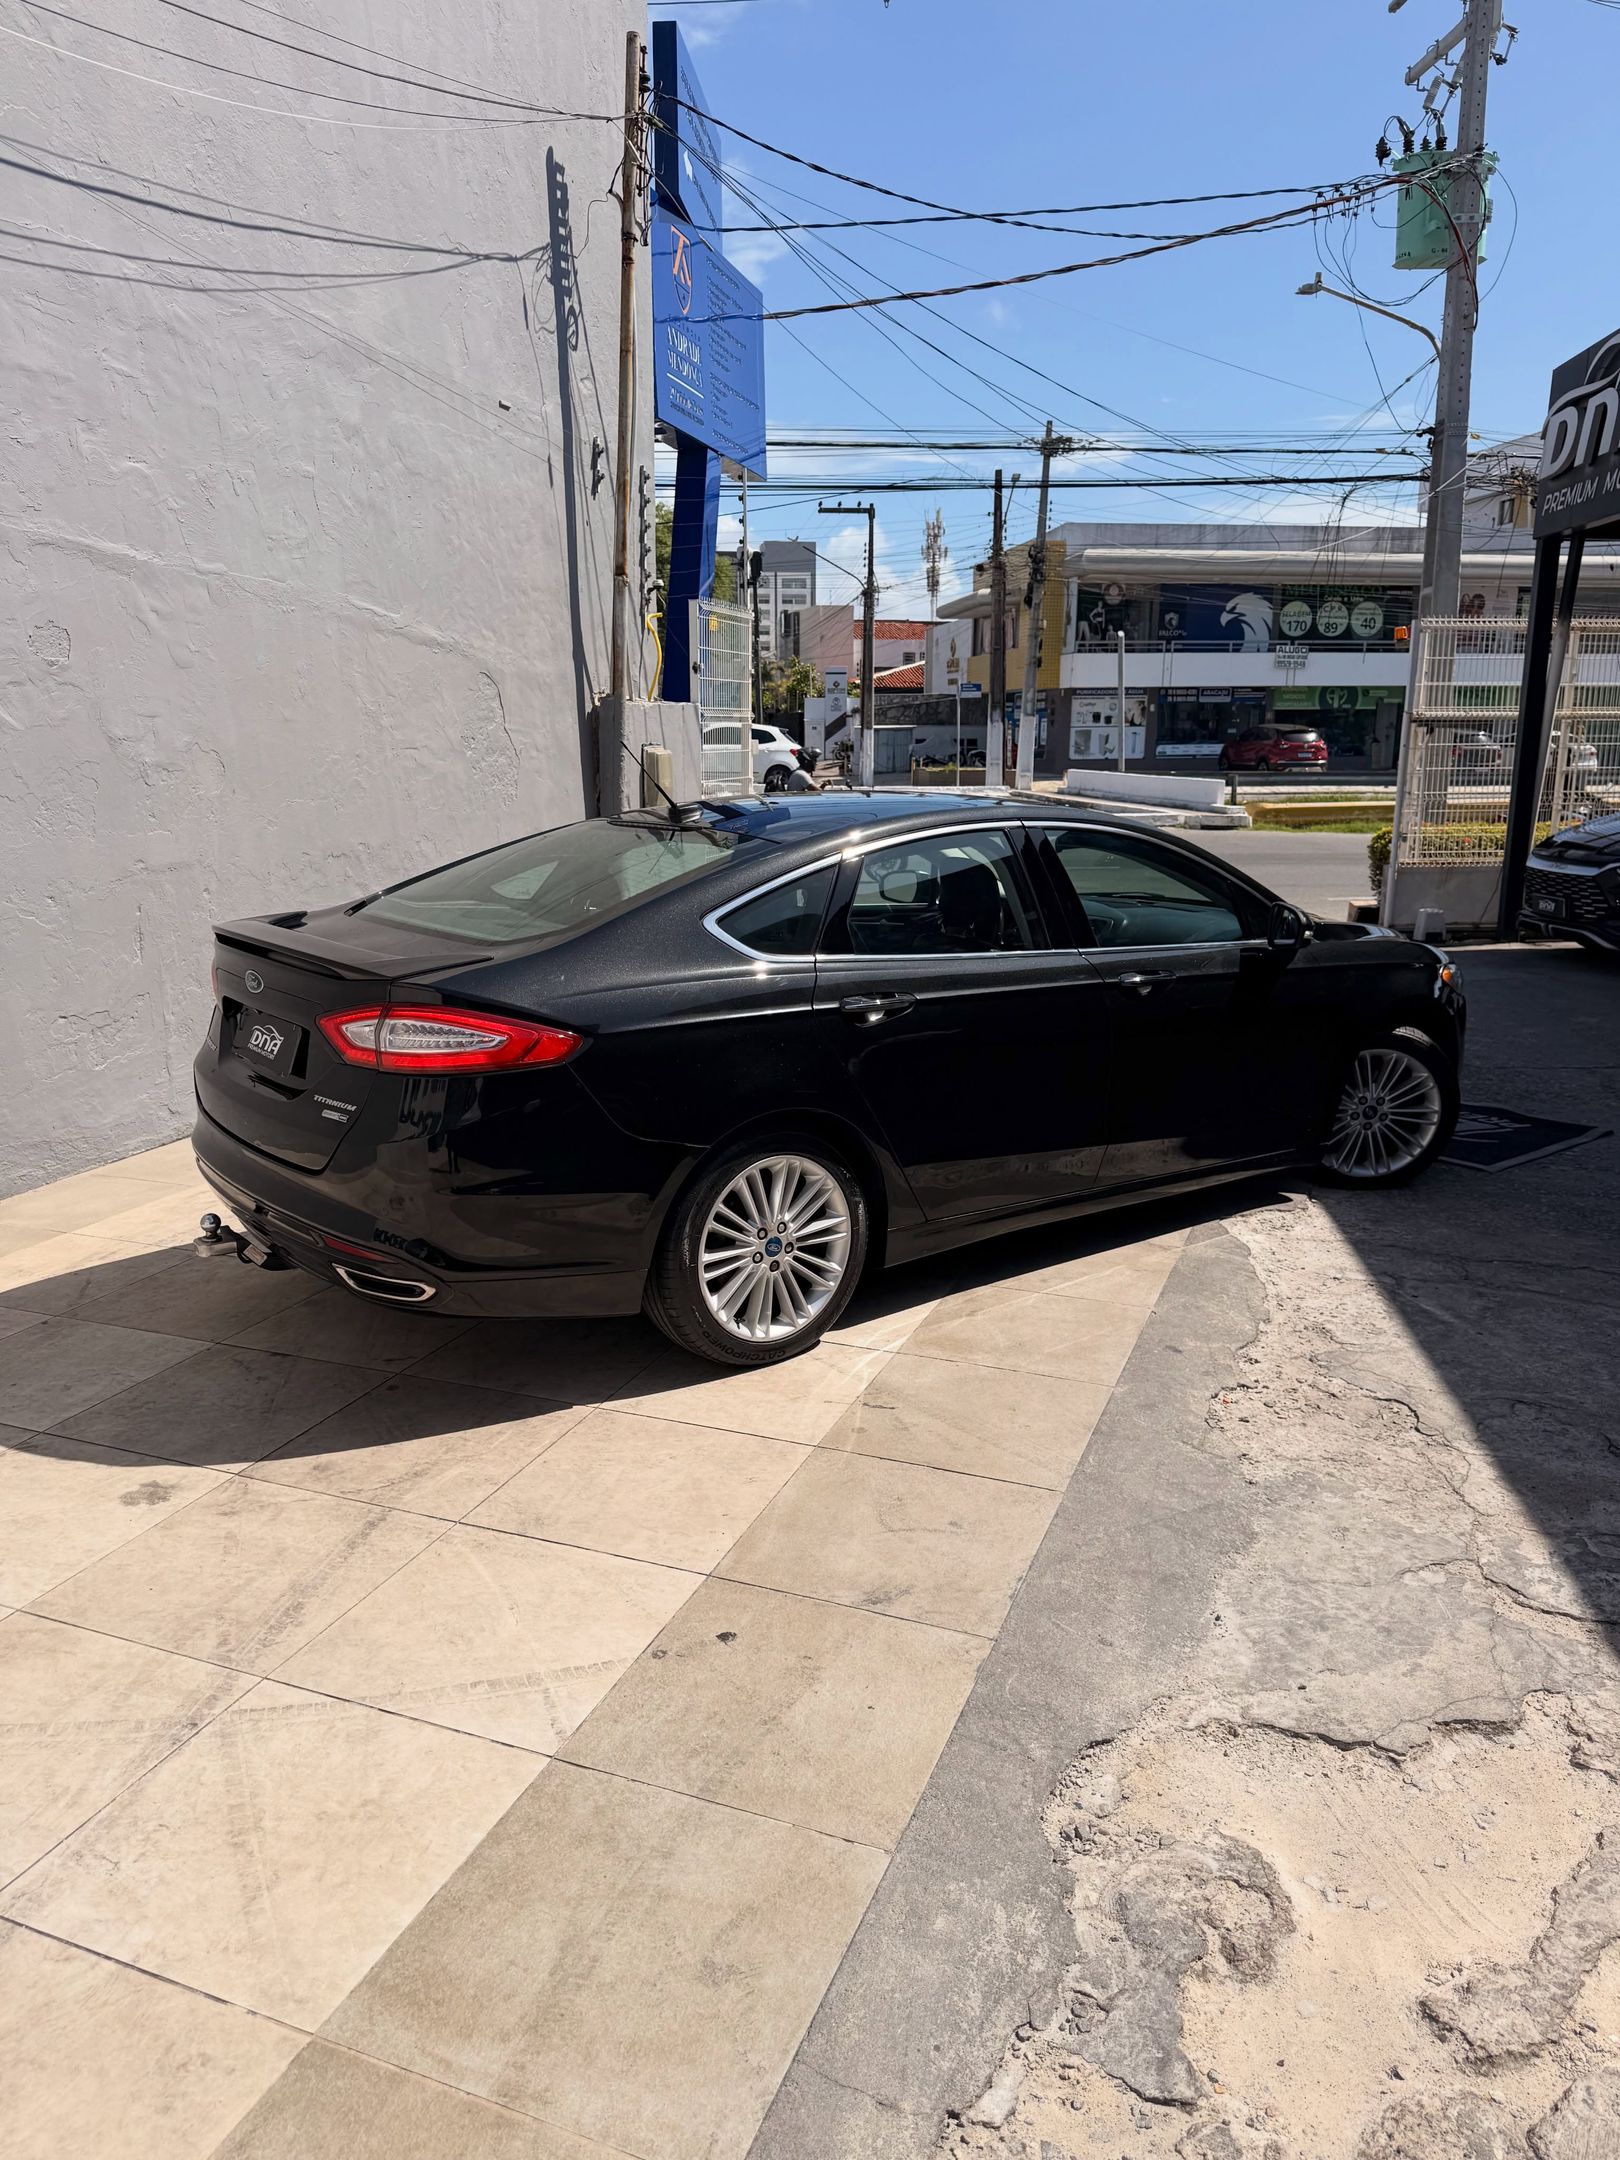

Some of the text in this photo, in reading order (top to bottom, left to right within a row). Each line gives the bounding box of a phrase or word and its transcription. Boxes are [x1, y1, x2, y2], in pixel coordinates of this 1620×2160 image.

[667, 324, 702, 367] ANDRADE
[1538, 386, 1620, 481] DN
[1542, 476, 1599, 516] PREMIUM
[1287, 620, 1308, 632] 170
[1323, 622, 1338, 633] 89
[1360, 617, 1376, 630] 40
[250, 1029, 282, 1055] DNA
[313, 1094, 357, 1111] TITANIUM
[702, 1330, 786, 1361] CATCHPOWER
